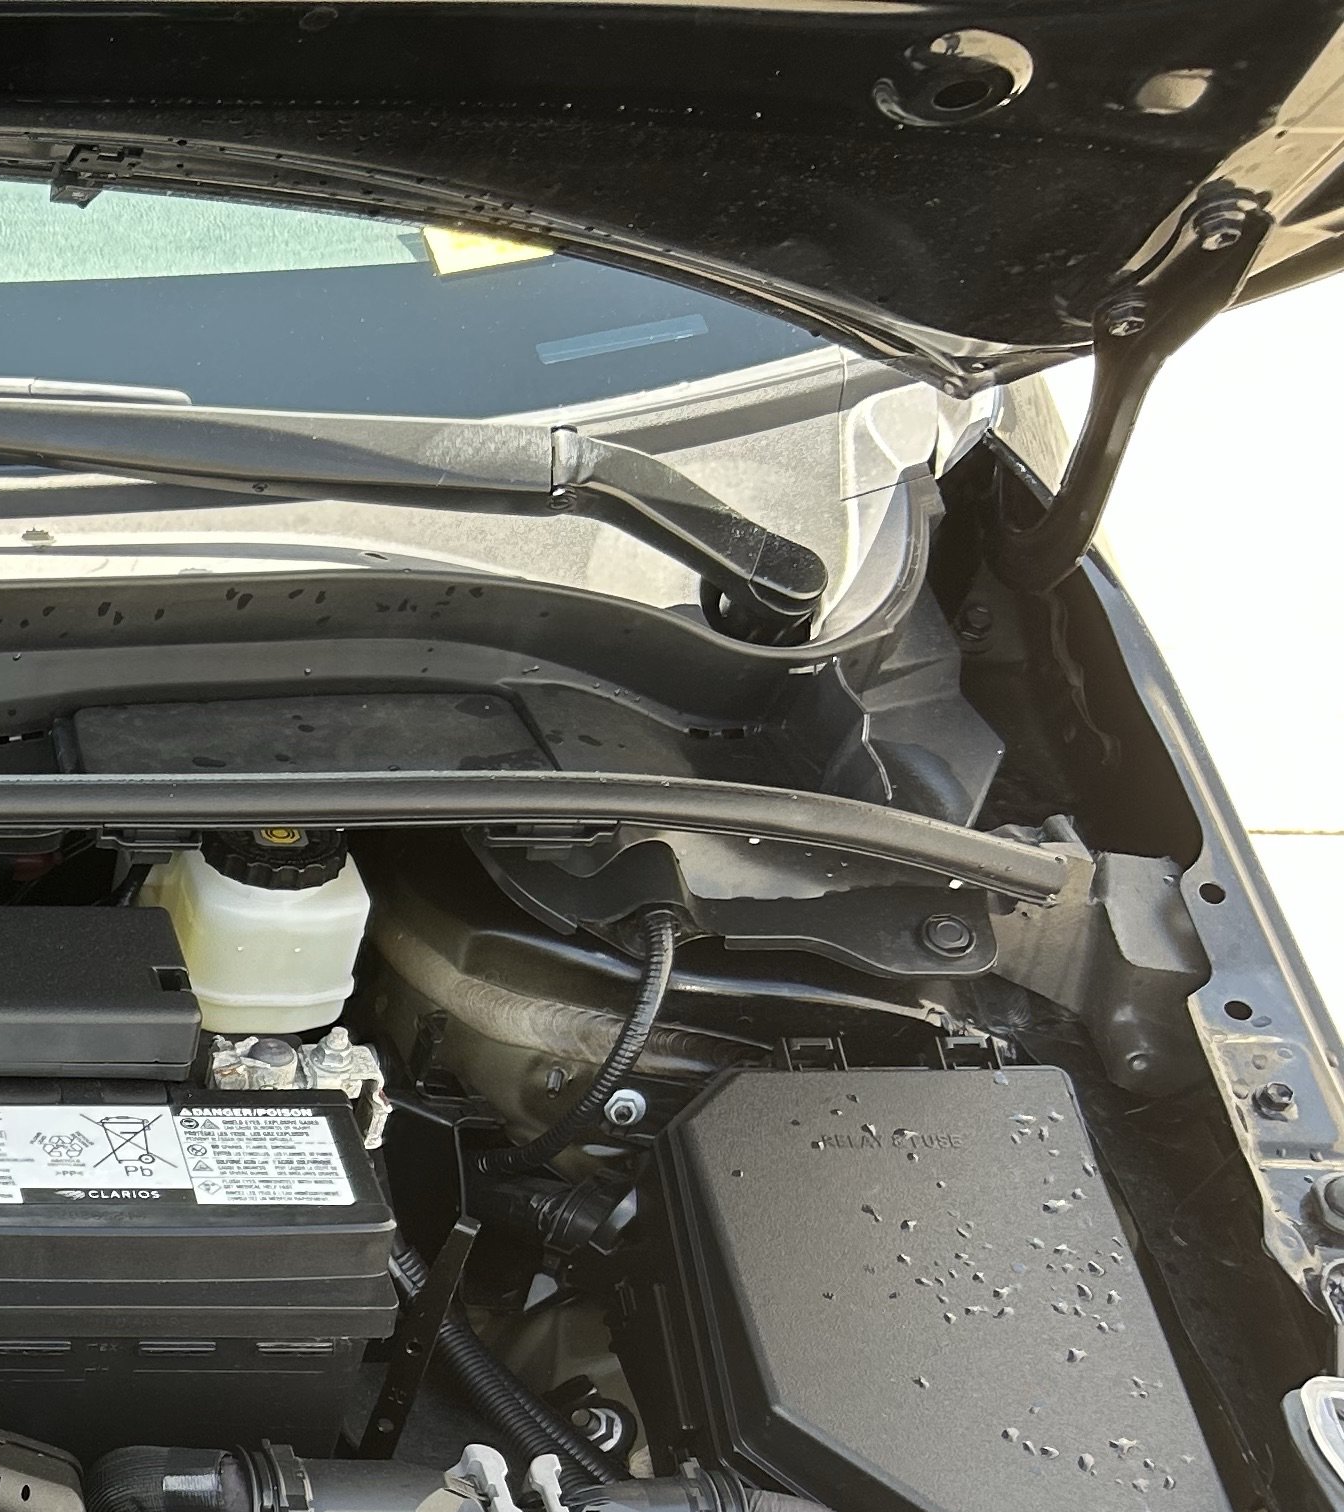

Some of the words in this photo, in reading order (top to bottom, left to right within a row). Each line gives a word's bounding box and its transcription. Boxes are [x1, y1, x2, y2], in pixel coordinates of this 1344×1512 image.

[192, 1107, 312, 1117] DANGER/POISON
[124, 1165, 154, 1177] Pb
[88, 1189, 161, 1199] CLARIOS
